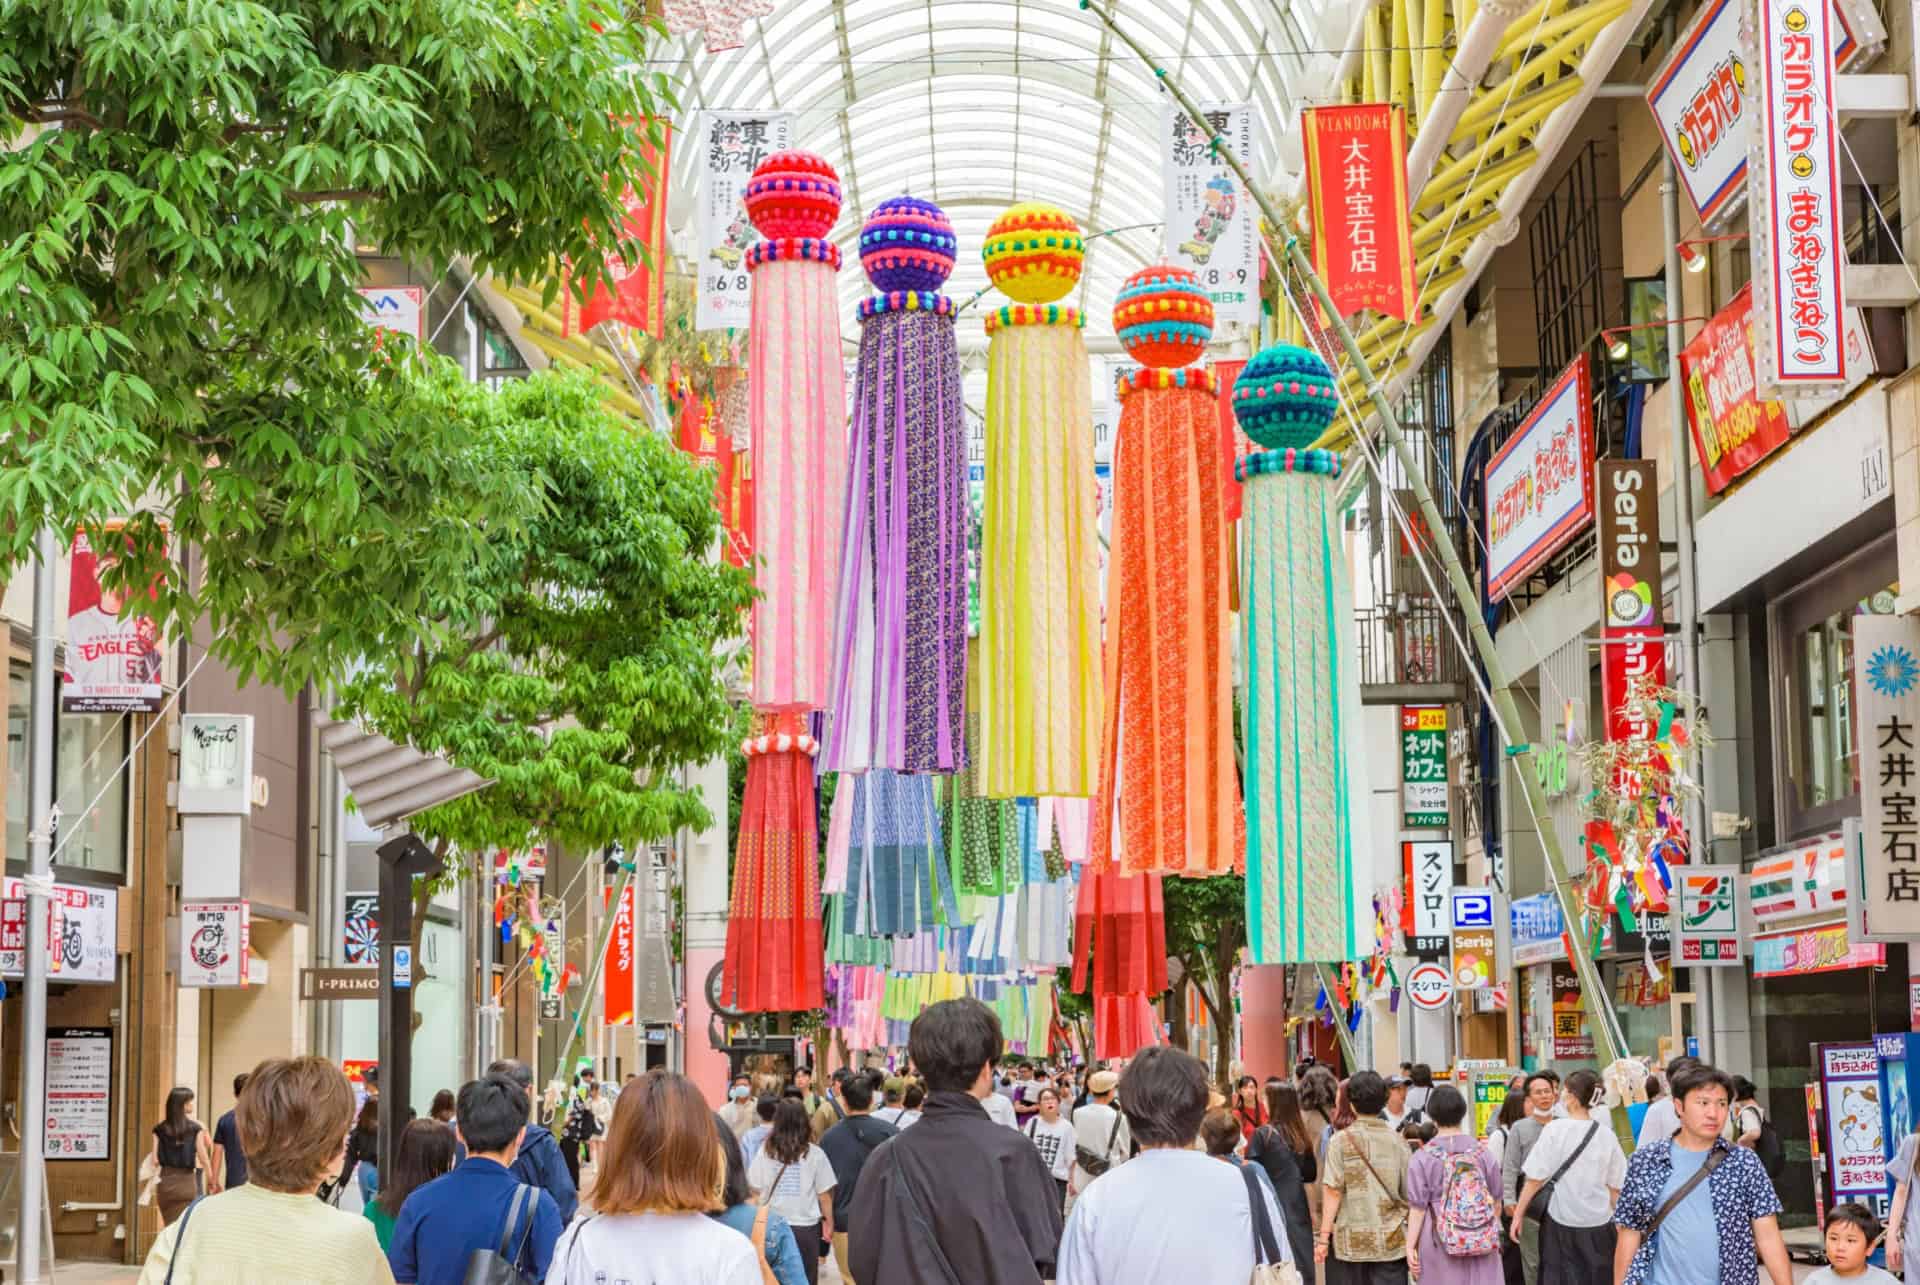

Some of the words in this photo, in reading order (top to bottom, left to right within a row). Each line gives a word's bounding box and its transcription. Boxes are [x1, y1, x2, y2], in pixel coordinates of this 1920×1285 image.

[1780, 33, 1815, 153] カラオケ
[1682, 64, 1741, 161] カラオケ
[1240, 111, 1250, 157] TOHOKU
[1342, 137, 1378, 273] 大井宝石店
[716, 275, 748, 292] 6/8
[1785, 186, 1828, 365] まねきねこ
[1496, 475, 1528, 538] カラオケ
[1613, 469, 1648, 568] Seria
[1403, 714, 1418, 727] 3F
[1405, 733, 1445, 755] ネット
[1406, 758, 1446, 779] カフェ
[1876, 716, 1920, 902] 大井宝石店
[1422, 851, 1443, 929] スシロー
[1416, 937, 1445, 950] B1F
[1454, 934, 1494, 949] Seria
[1719, 943, 1738, 957] ATM
[319, 978, 380, 990] I-PRIMO
[1410, 980, 1451, 992] スシロー
[1557, 1012, 1578, 1035] 薬
